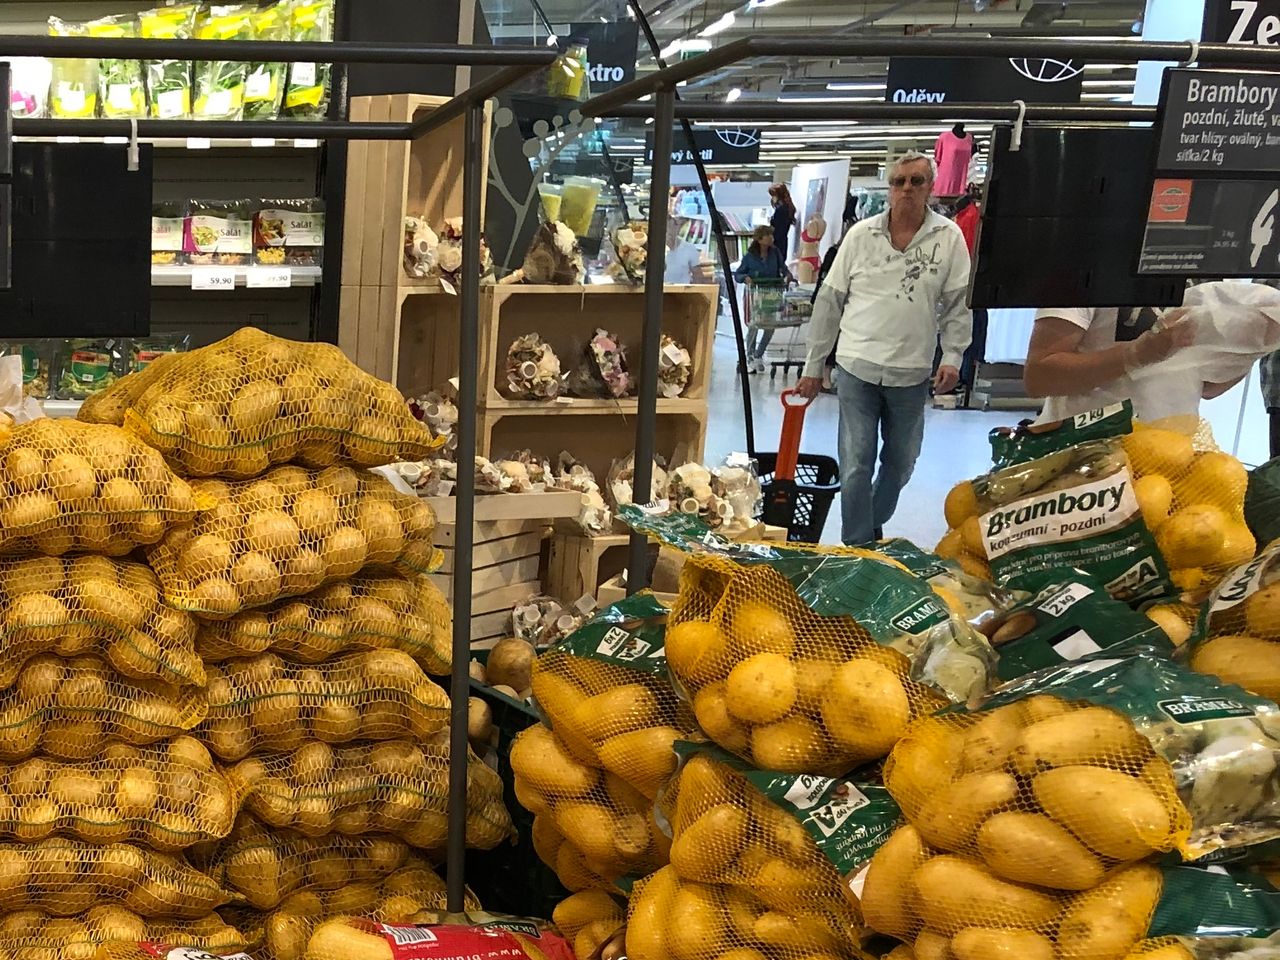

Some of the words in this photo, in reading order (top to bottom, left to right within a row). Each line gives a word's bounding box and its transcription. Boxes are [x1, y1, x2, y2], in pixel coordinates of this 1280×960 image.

[586, 62, 624, 82] ktro
[1186, 79, 1278, 111] Brambory
[1182, 108, 1230, 128] pozdní,
[1233, 109, 1268, 128] žluté,
[1179, 132, 1200, 145] tvar
[686, 149, 713, 160] tetil
[1211, 150, 1224, 166] kg
[1078, 413, 1088, 427] 2
[1088, 407, 1105, 422] kg
[987, 480, 1126, 537] Brambory
[990, 523, 1049, 551] konzumní
[1060, 514, 1106, 536] pozdní
[1049, 602, 1063, 615] 2
[1165, 698, 1244, 716] BRAMKO
